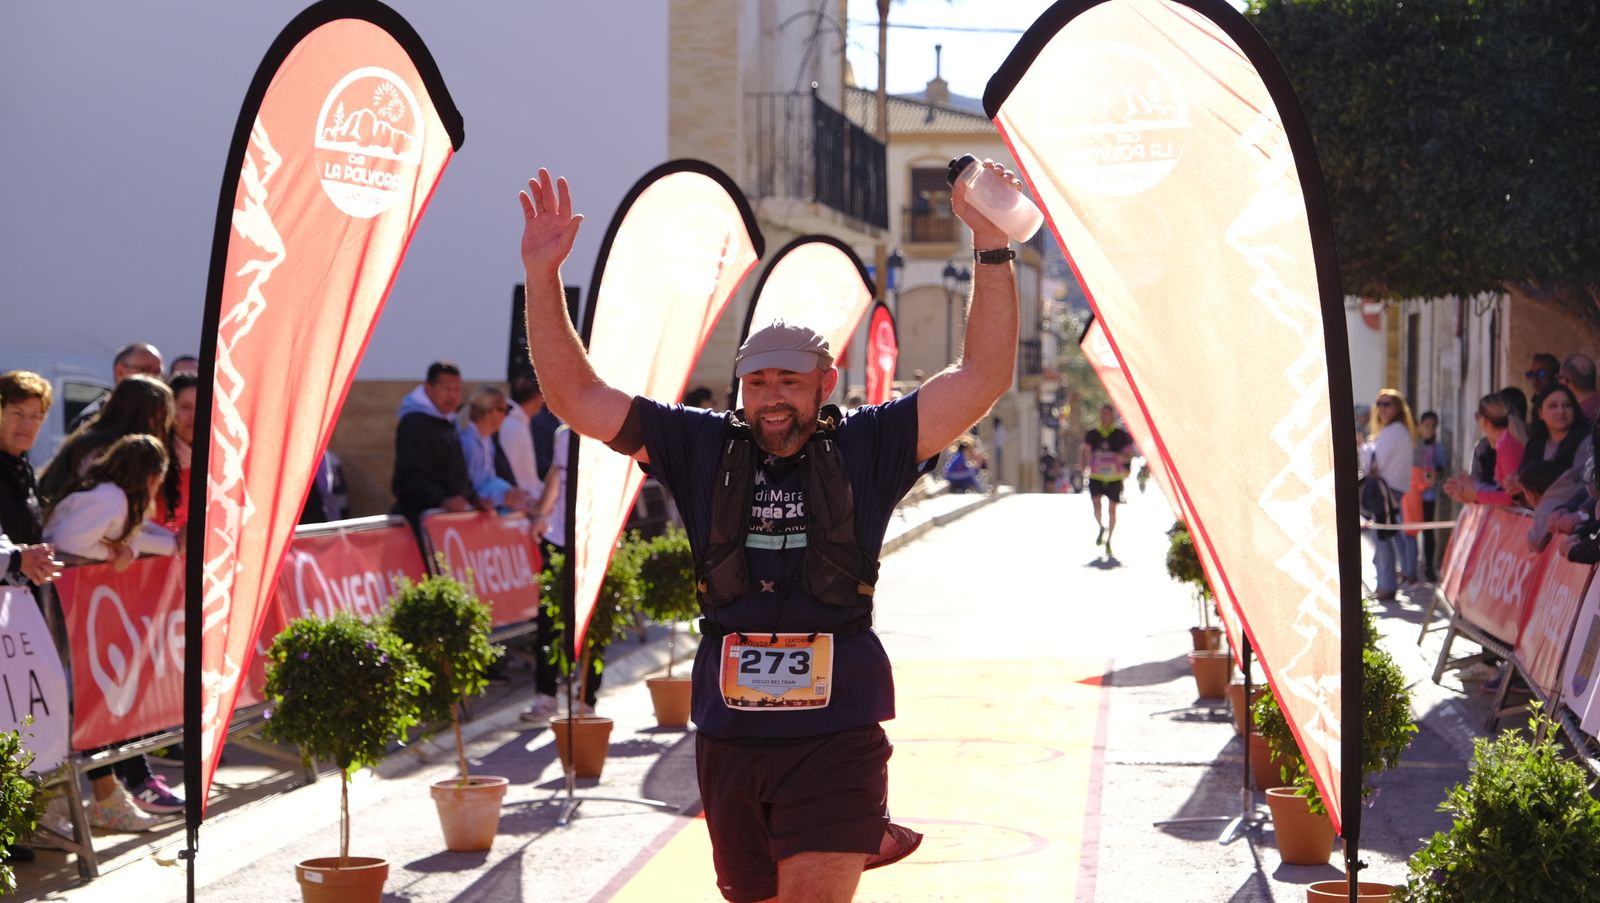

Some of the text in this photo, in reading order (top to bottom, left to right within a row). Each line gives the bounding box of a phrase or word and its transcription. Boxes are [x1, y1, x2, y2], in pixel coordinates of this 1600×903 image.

[325, 161, 341, 179] LA
[2, 632, 34, 659] DE
[740, 649, 811, 676] 273
